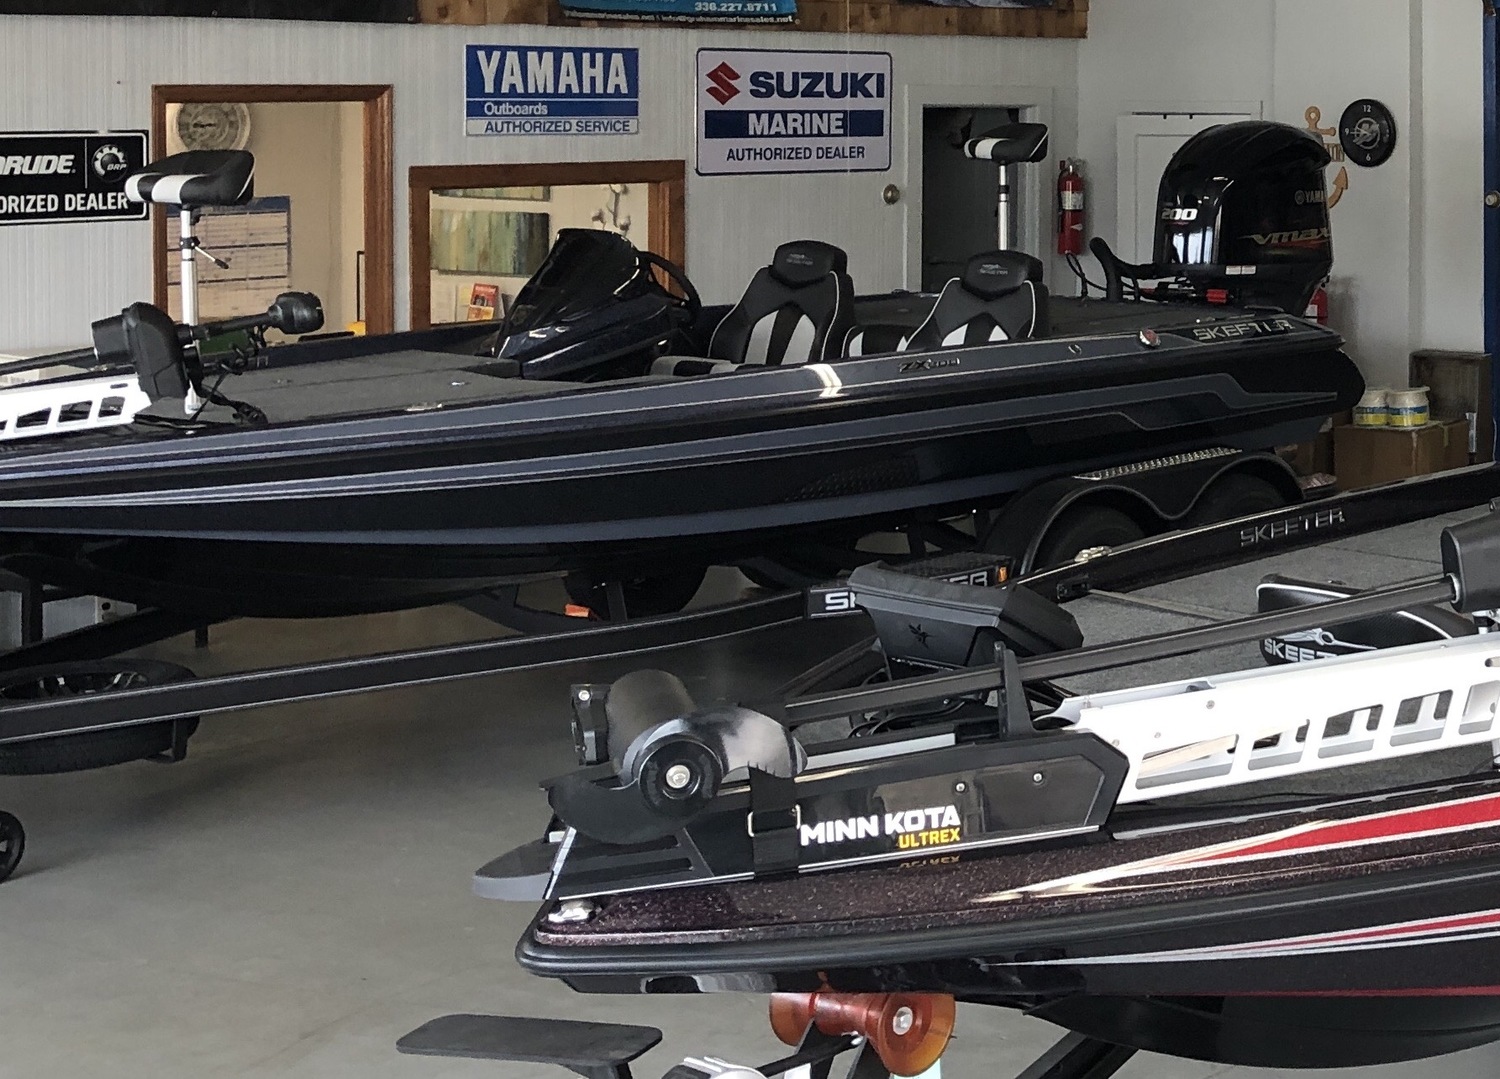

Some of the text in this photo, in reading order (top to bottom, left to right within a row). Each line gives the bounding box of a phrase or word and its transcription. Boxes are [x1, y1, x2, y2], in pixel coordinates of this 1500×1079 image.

[477, 50, 629, 94] YAMAHA
[749, 71, 885, 99] SUZUKI
[484, 102, 548, 115] Outboards
[1363, 105, 1372, 113] 12
[485, 120, 630, 133] AUTHORIZED SERVICE
[748, 112, 844, 136] MARINE
[1344, 128, 1350, 136] 9
[726, 146, 865, 162] AUTHORIZED DEALER
[1366, 154, 1371, 162] 6
[65, 192, 128, 211] DEALER
[1162, 208, 1198, 220] 200
[1240, 508, 1345, 547] SKEETER
[800, 805, 961, 846] MINN KOTA
[899, 827, 960, 848] ULTREX
